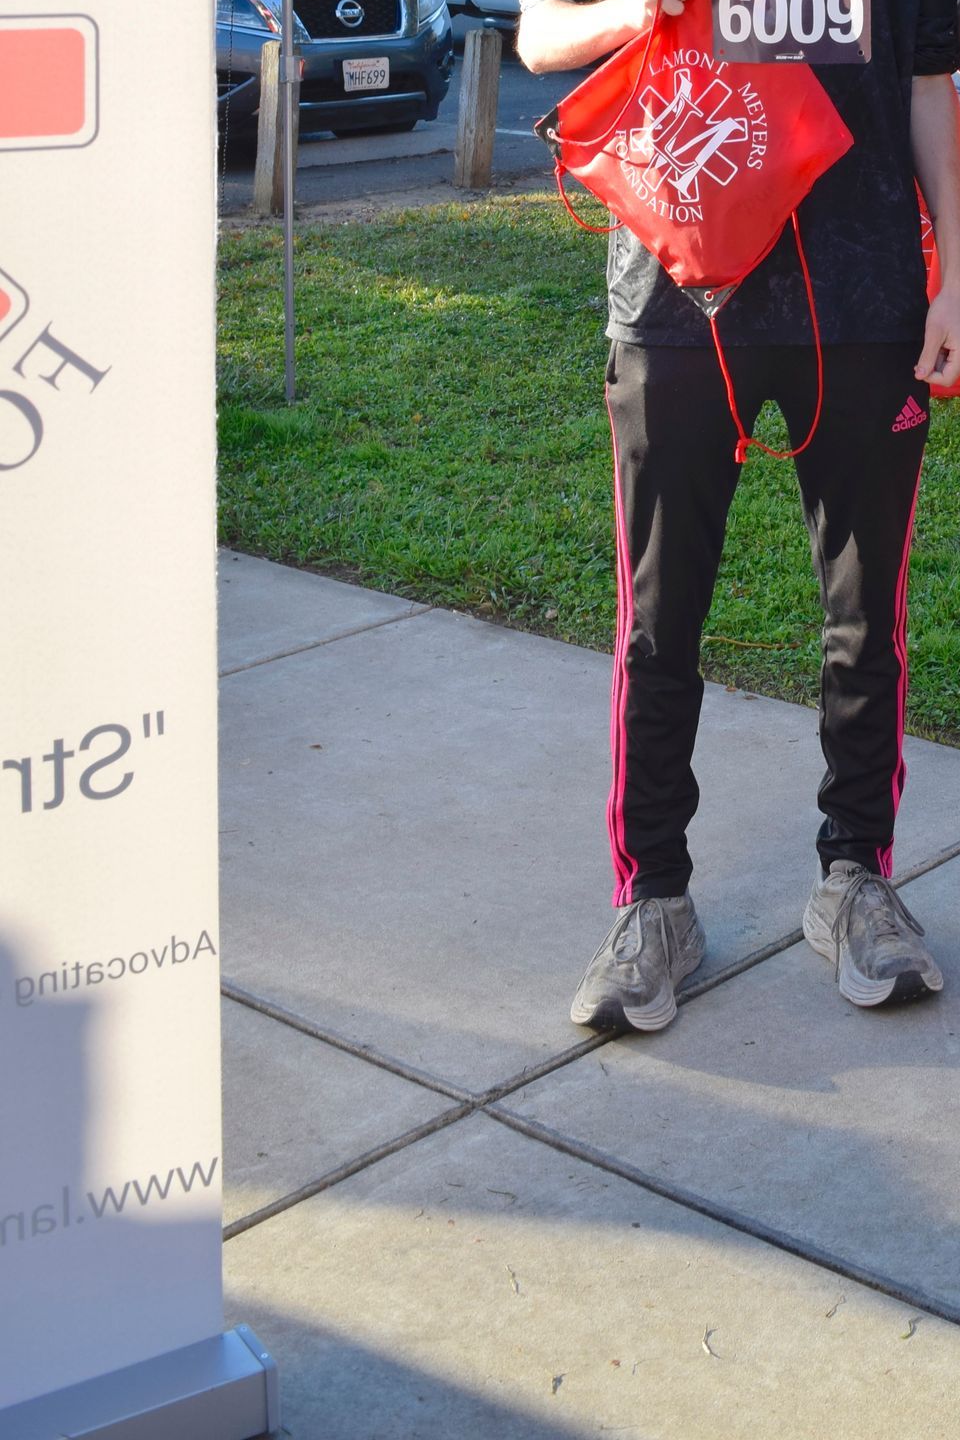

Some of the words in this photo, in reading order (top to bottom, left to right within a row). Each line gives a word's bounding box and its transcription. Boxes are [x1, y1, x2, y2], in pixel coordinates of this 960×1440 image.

[649, 48, 729, 77] LAMONT
[737, 81, 768, 171] MEYERS
[891, 411, 927, 433] adidas
